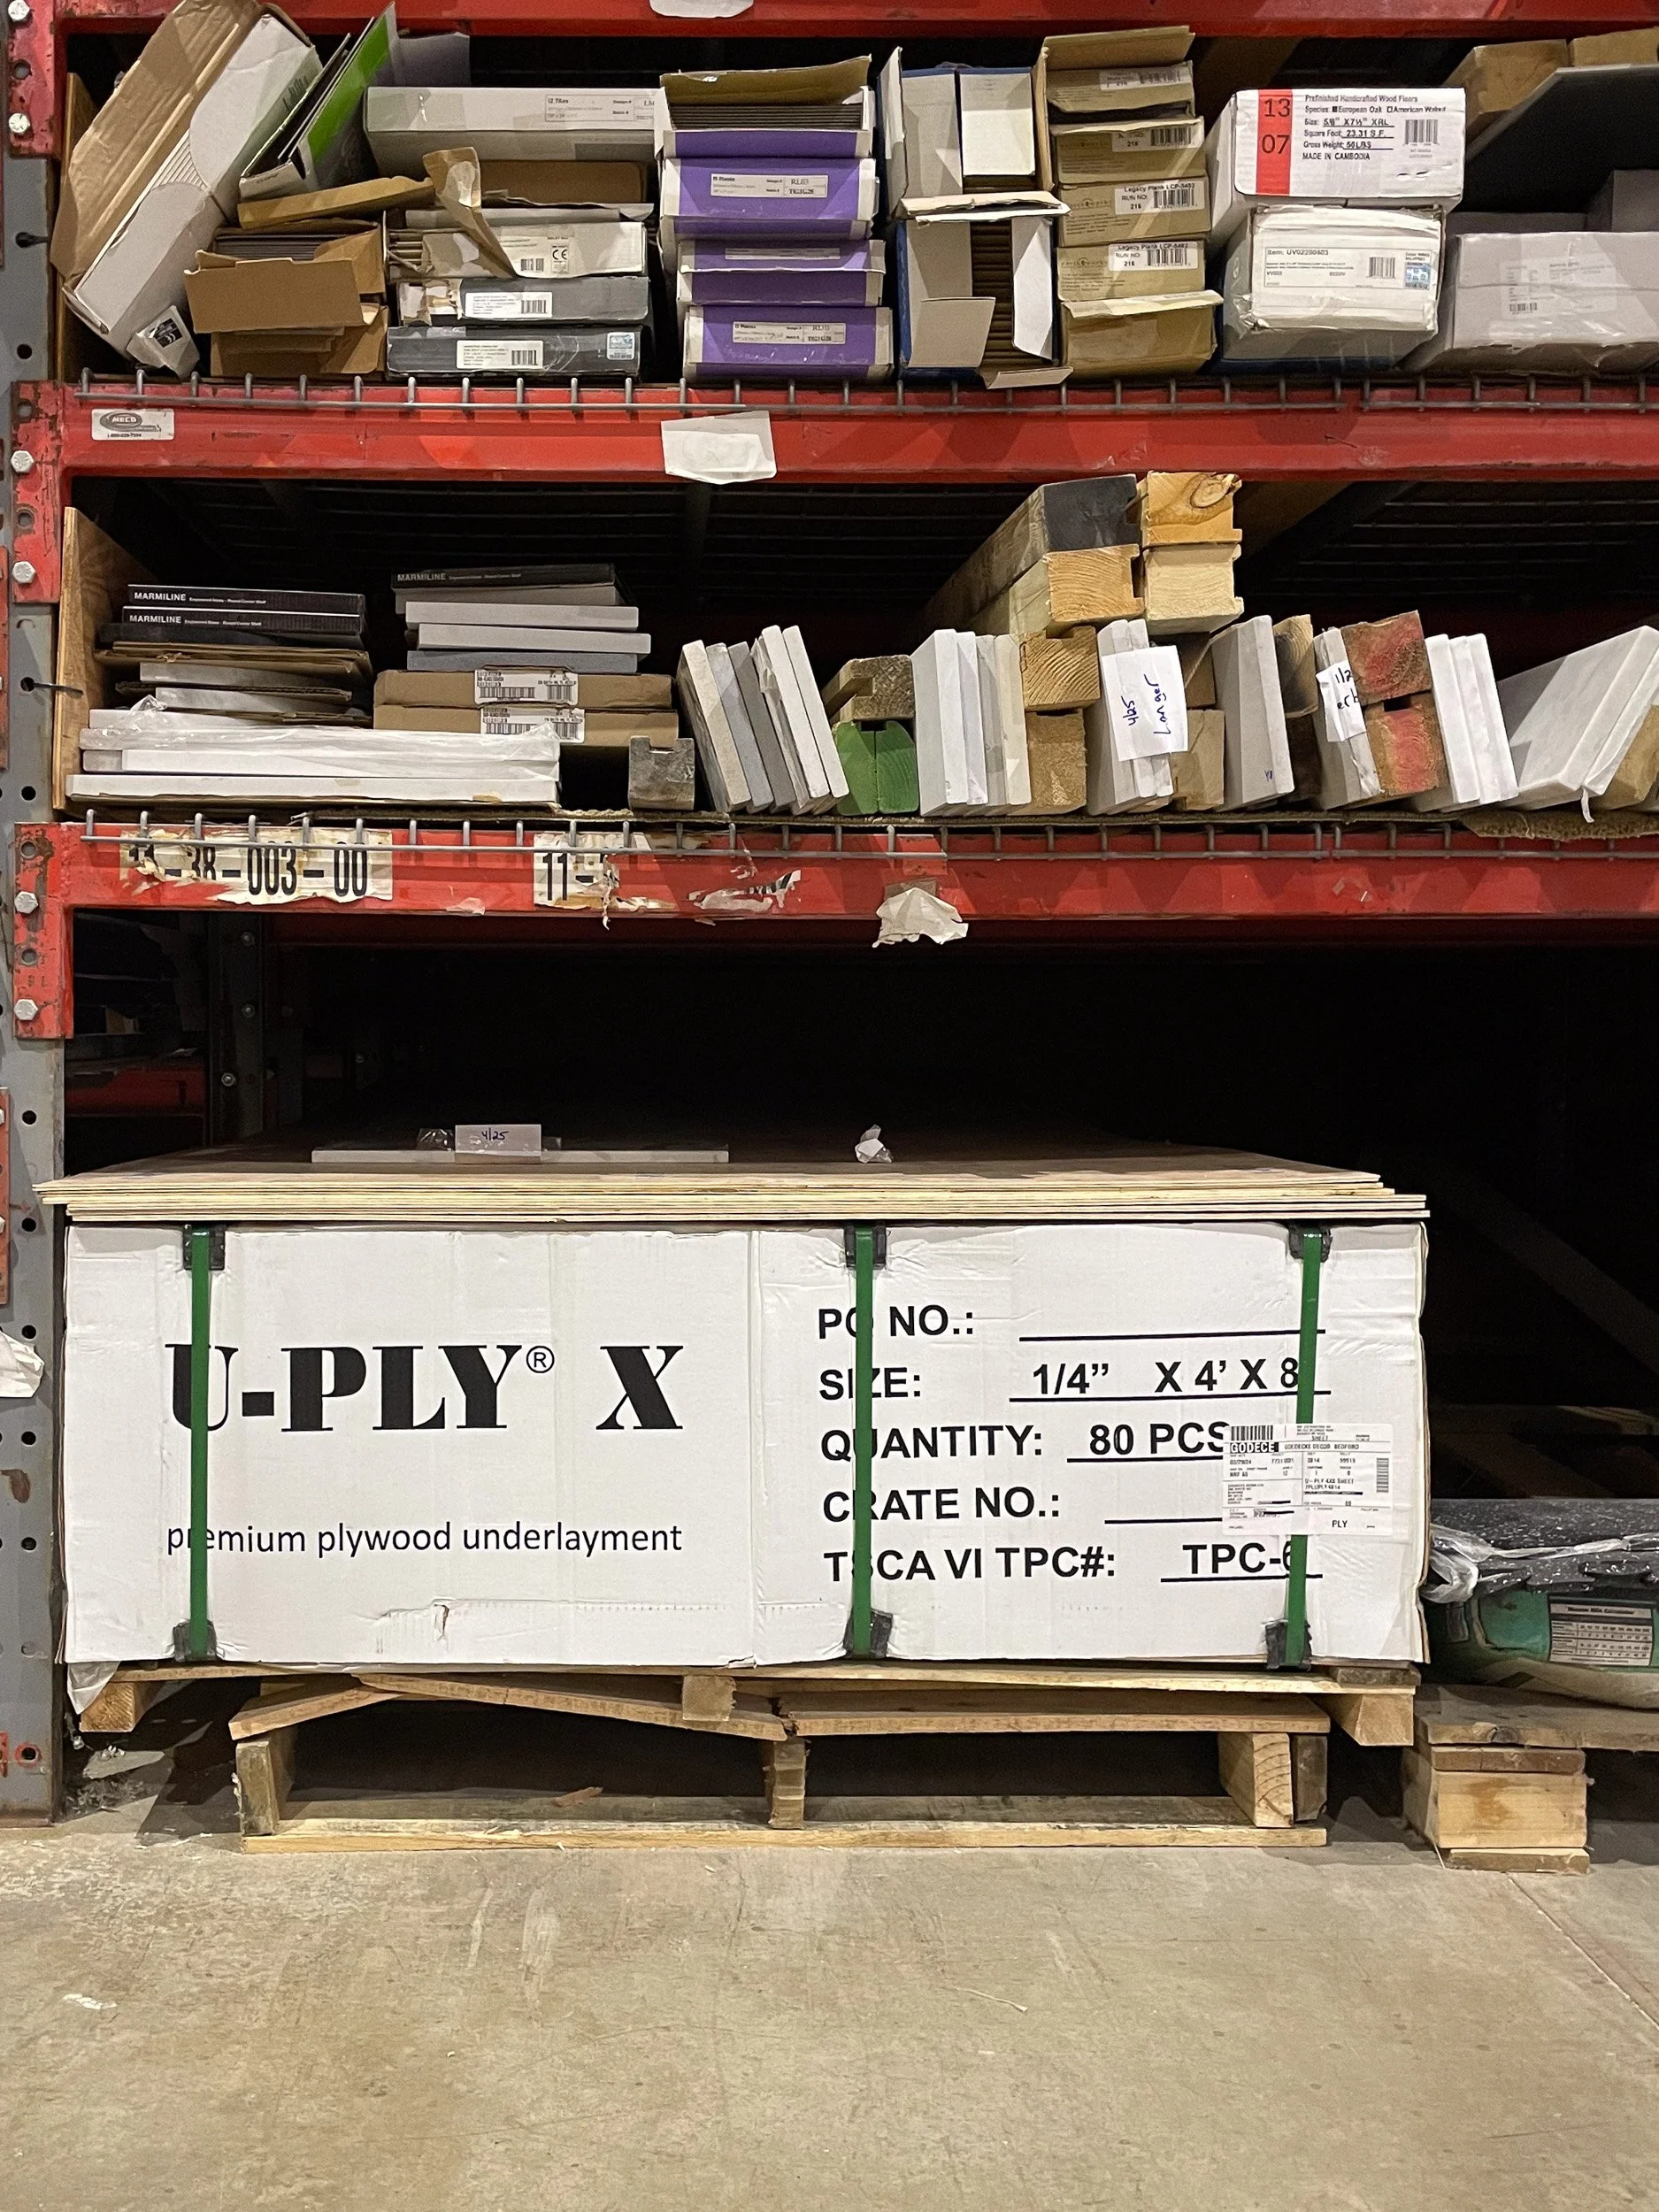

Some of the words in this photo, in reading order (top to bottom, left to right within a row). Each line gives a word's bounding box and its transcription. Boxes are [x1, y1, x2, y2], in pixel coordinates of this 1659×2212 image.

[1263, 97, 1291, 119] 13
[1339, 106, 1368, 115] European
[1399, 95, 1418, 104] Floors
[1261, 134, 1291, 155] 07
[134, 592, 187, 602] MARMILINE
[129, 615, 181, 624] MARMILINE
[889, 1304, 973, 1336] NO.:
[1154, 1361, 1183, 1393] X
[1240, 1358, 1268, 1390] X
[595, 1345, 684, 1431] X
[1089, 1425, 1134, 1455] 80
[1150, 1421, 1231, 1455] PCS
[1231, 1442, 1275, 1454] GODECE
[975, 1486, 1059, 1518] NO.:
[1332, 1519, 1348, 1528] PLY
[318, 1521, 452, 1559] plywood
[463, 1520, 683, 1558] underlayment
[823, 1549, 936, 1582] TCA
[944, 1548, 982, 1579] VI
[995, 1546, 1115, 1578] TPC#:
